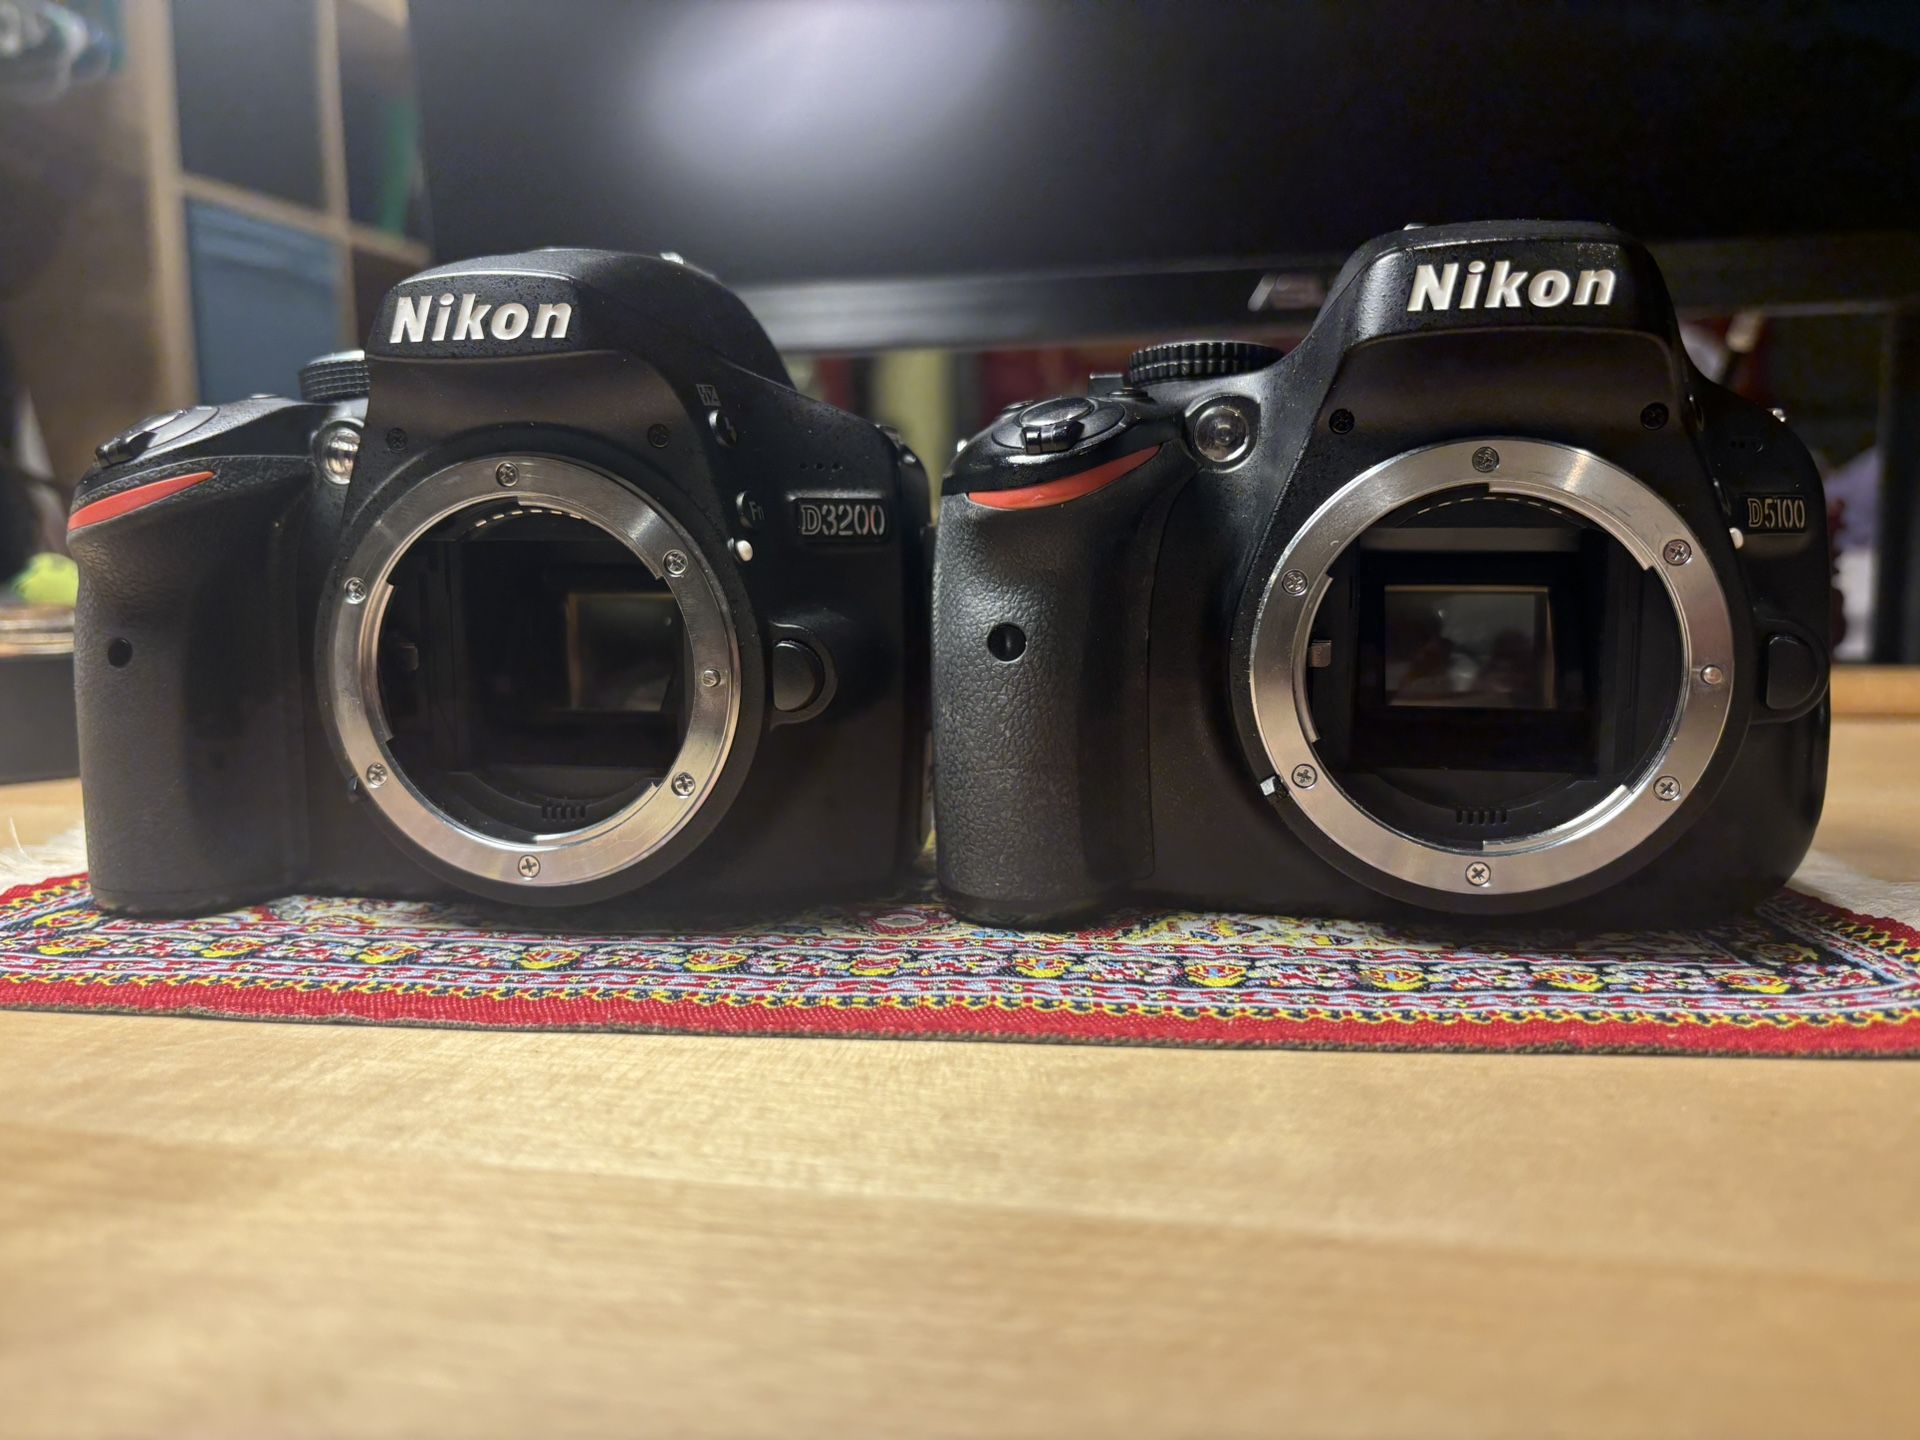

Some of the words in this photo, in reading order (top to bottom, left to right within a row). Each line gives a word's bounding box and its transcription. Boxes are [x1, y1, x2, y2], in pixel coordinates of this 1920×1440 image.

[1407, 260, 1616, 312] Nikon
[389, 292, 572, 344] Nikon
[801, 505, 885, 535] D3200
[1747, 498, 1806, 528] D5100
